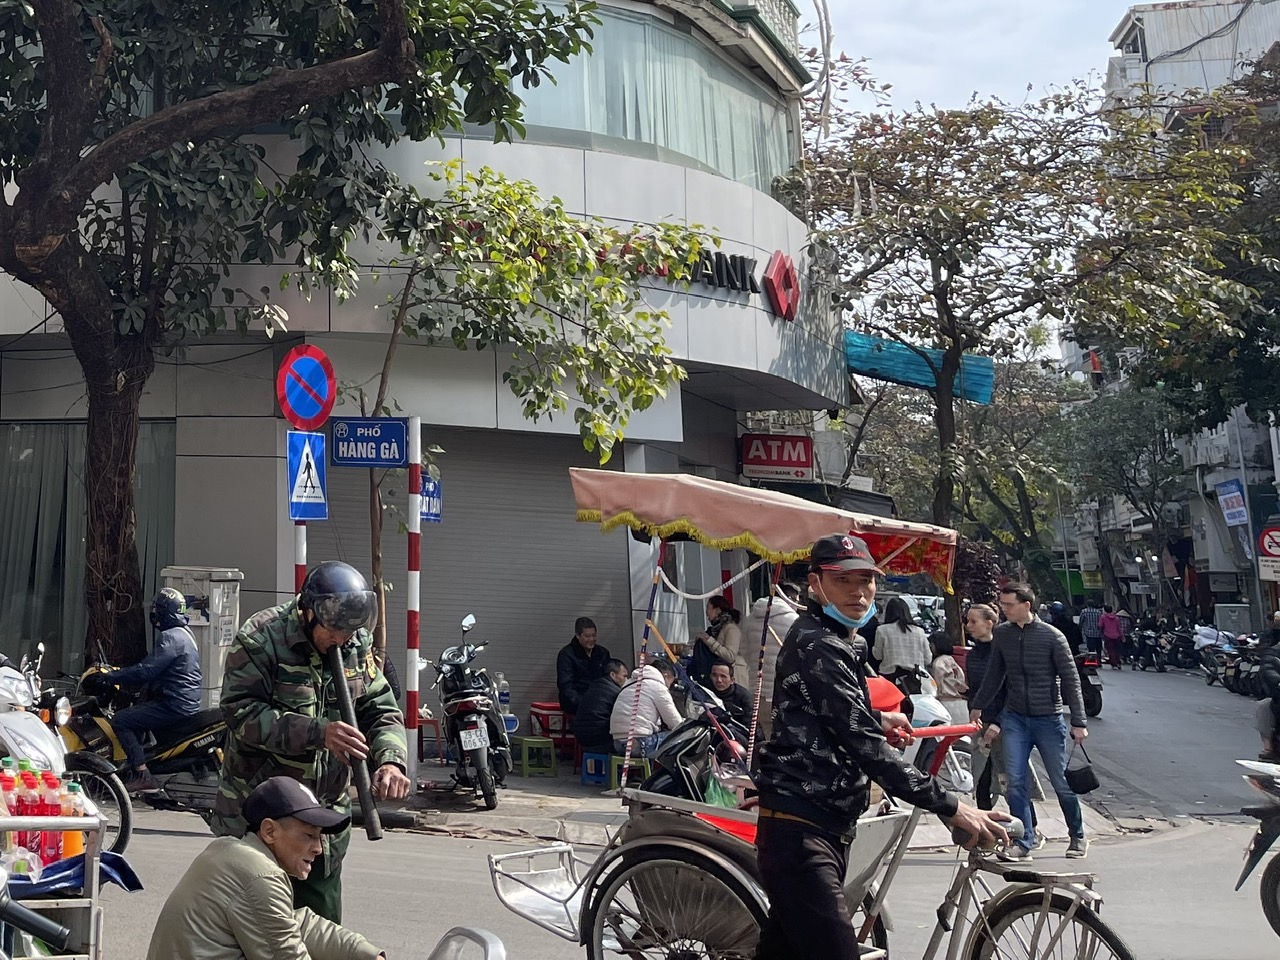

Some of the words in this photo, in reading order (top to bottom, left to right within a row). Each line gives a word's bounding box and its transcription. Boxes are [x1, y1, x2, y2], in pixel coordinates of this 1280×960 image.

[688, 248, 761, 294] ANK
[357, 424, 381, 437] PHỐ
[338, 438, 376, 459] HÀNG
[380, 439, 400, 459] GÀ
[748, 439, 807, 462] ATM
[193, 734, 216, 749] YAMAHA
